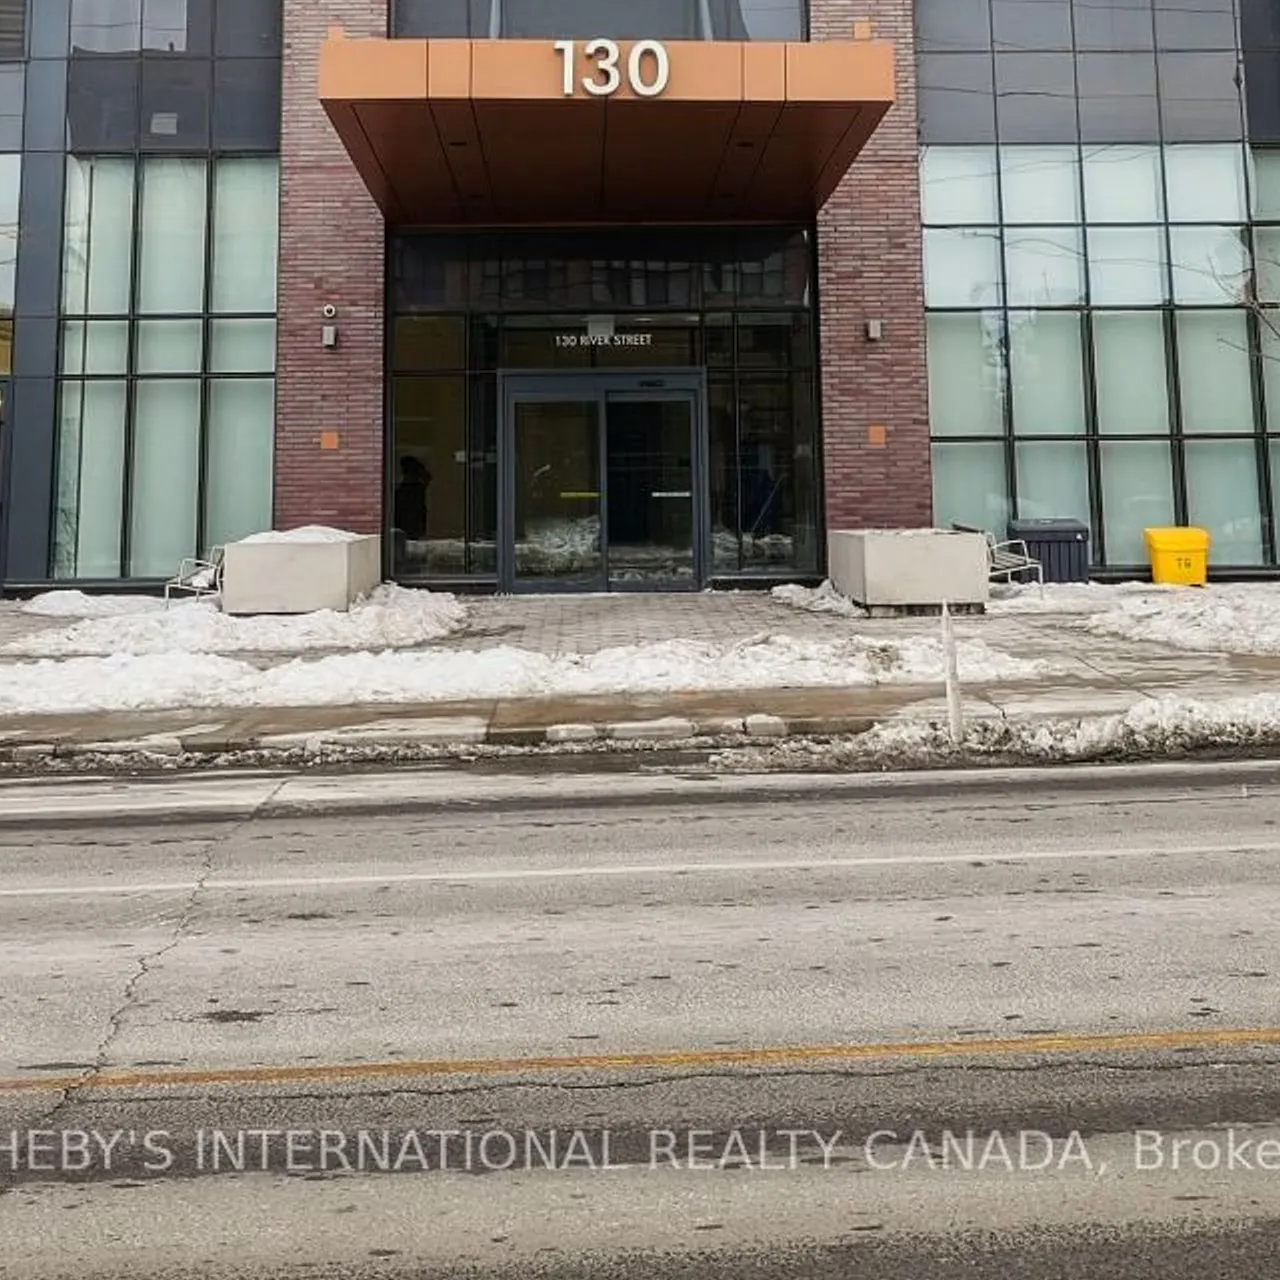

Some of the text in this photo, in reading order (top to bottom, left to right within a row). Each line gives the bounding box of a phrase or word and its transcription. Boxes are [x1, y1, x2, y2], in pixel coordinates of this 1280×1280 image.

[554, 39, 669, 96] 130
[554, 335, 577, 348] 130
[613, 334, 653, 346] STREET
